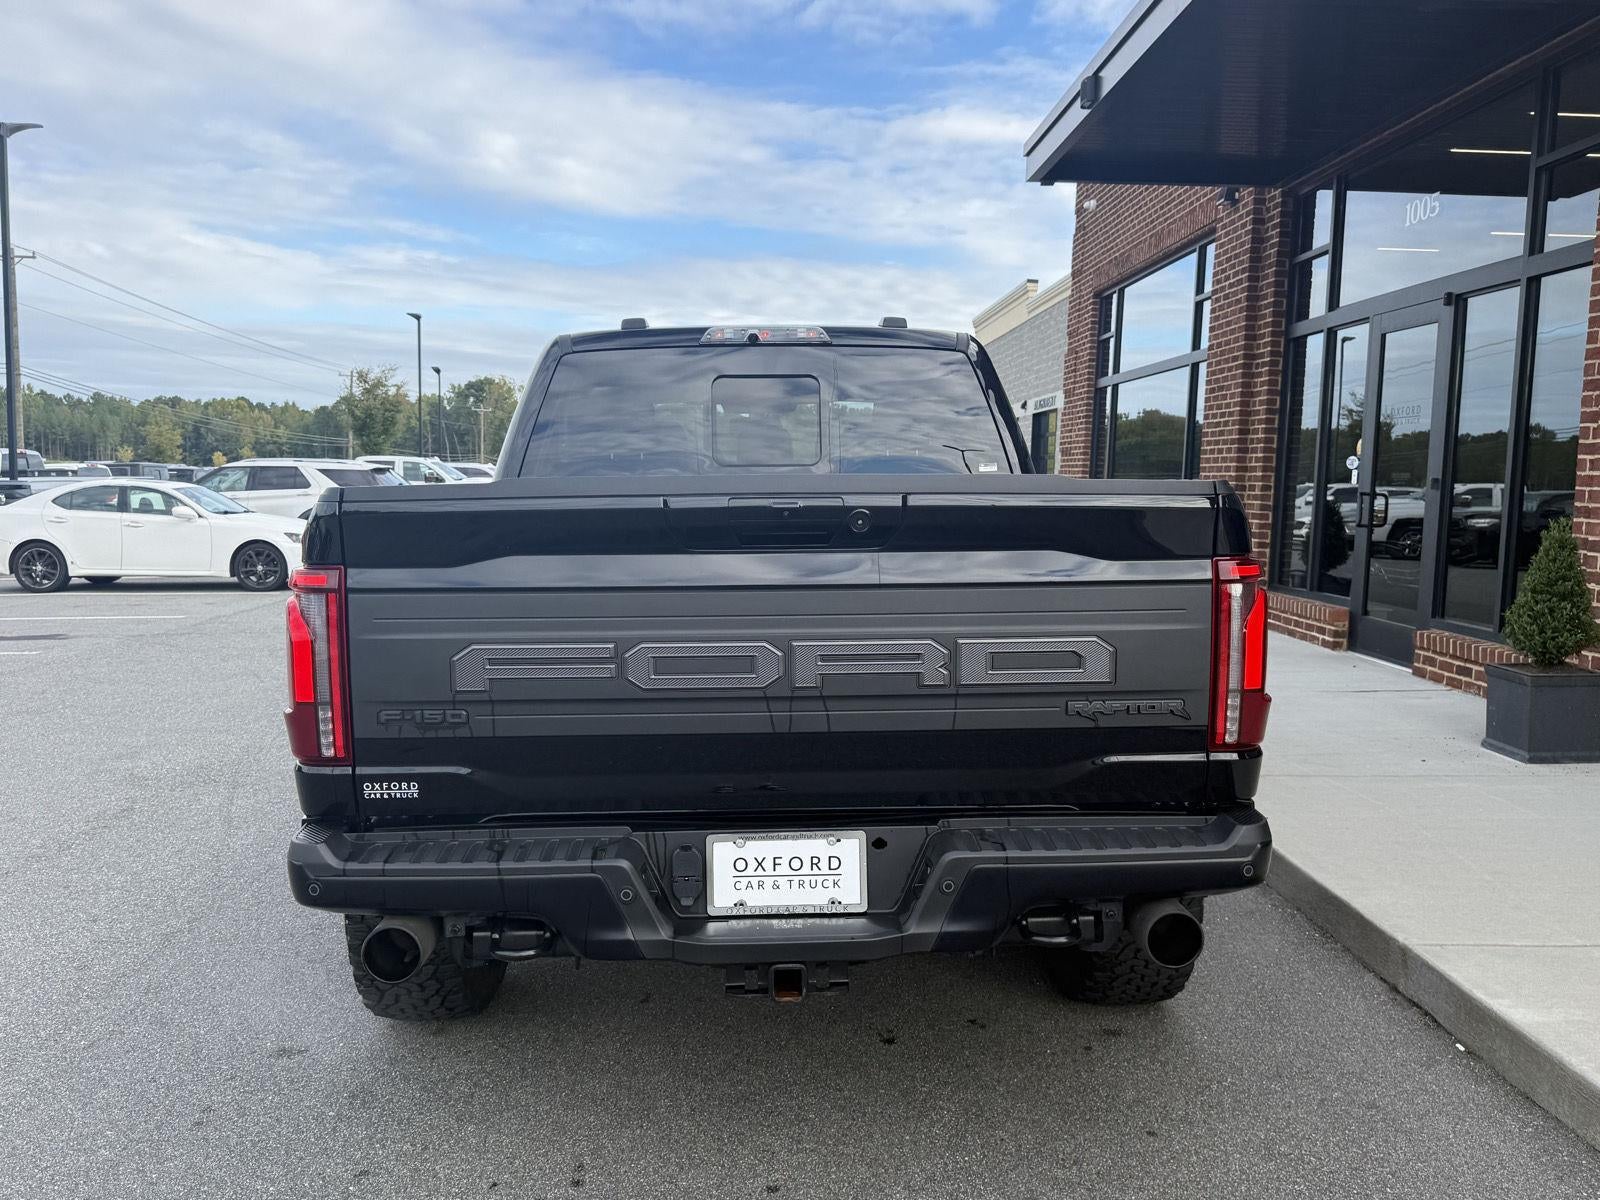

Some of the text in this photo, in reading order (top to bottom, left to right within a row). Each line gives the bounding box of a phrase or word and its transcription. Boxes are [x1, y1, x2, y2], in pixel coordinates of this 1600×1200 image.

[1404, 191, 1441, 227] 1005
[452, 636, 1117, 693] FORD
[377, 708, 469, 725] F-150
[1066, 698, 1192, 722] RAPTOR
[363, 782, 419, 791] OXFORD
[733, 856, 842, 873] OXFORD
[733, 878, 842, 891] CAR & TRUCK
[725, 905, 773, 914] OXFORD
[813, 905, 849, 913] TRUCK
